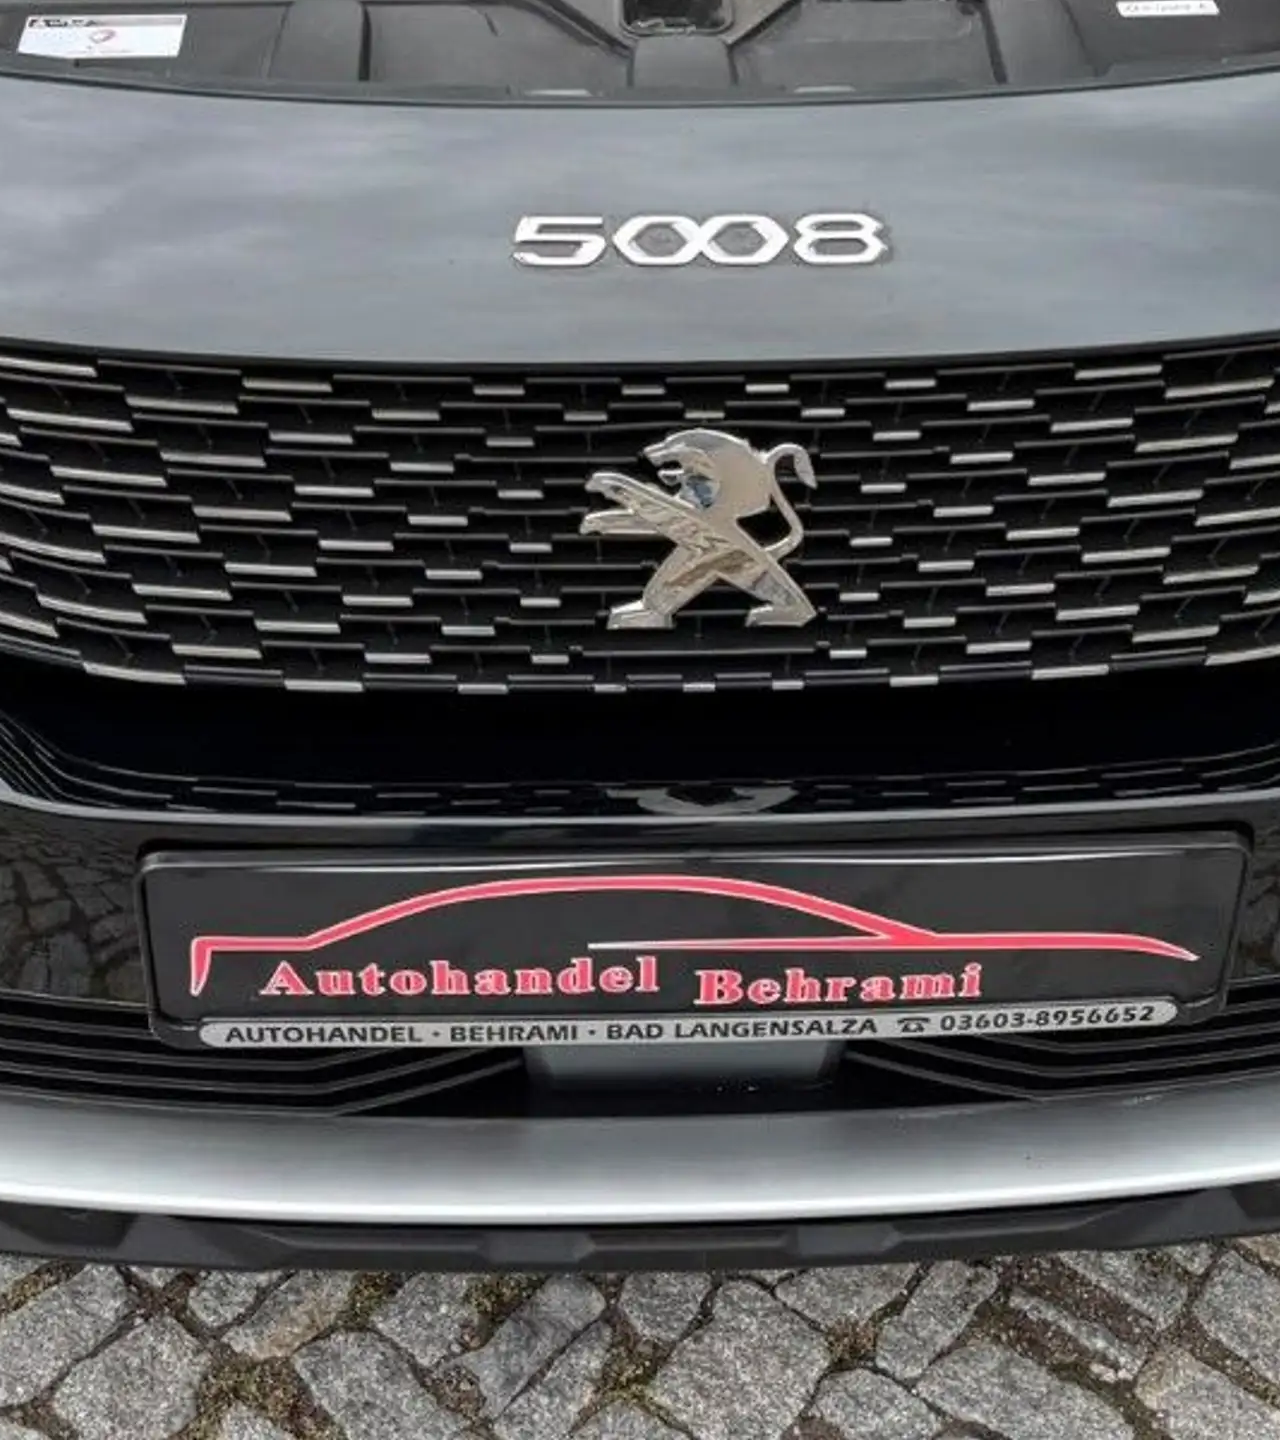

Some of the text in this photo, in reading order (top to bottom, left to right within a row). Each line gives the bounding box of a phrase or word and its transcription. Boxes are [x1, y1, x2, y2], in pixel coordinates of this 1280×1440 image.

[512, 212, 888, 267] 5008
[259, 956, 984, 1006] Autohandel Behrami
[225, 1003, 1157, 1044] AUTOHANDEL BEHRAMI BAD LANGENSALZA 03603-8956652
